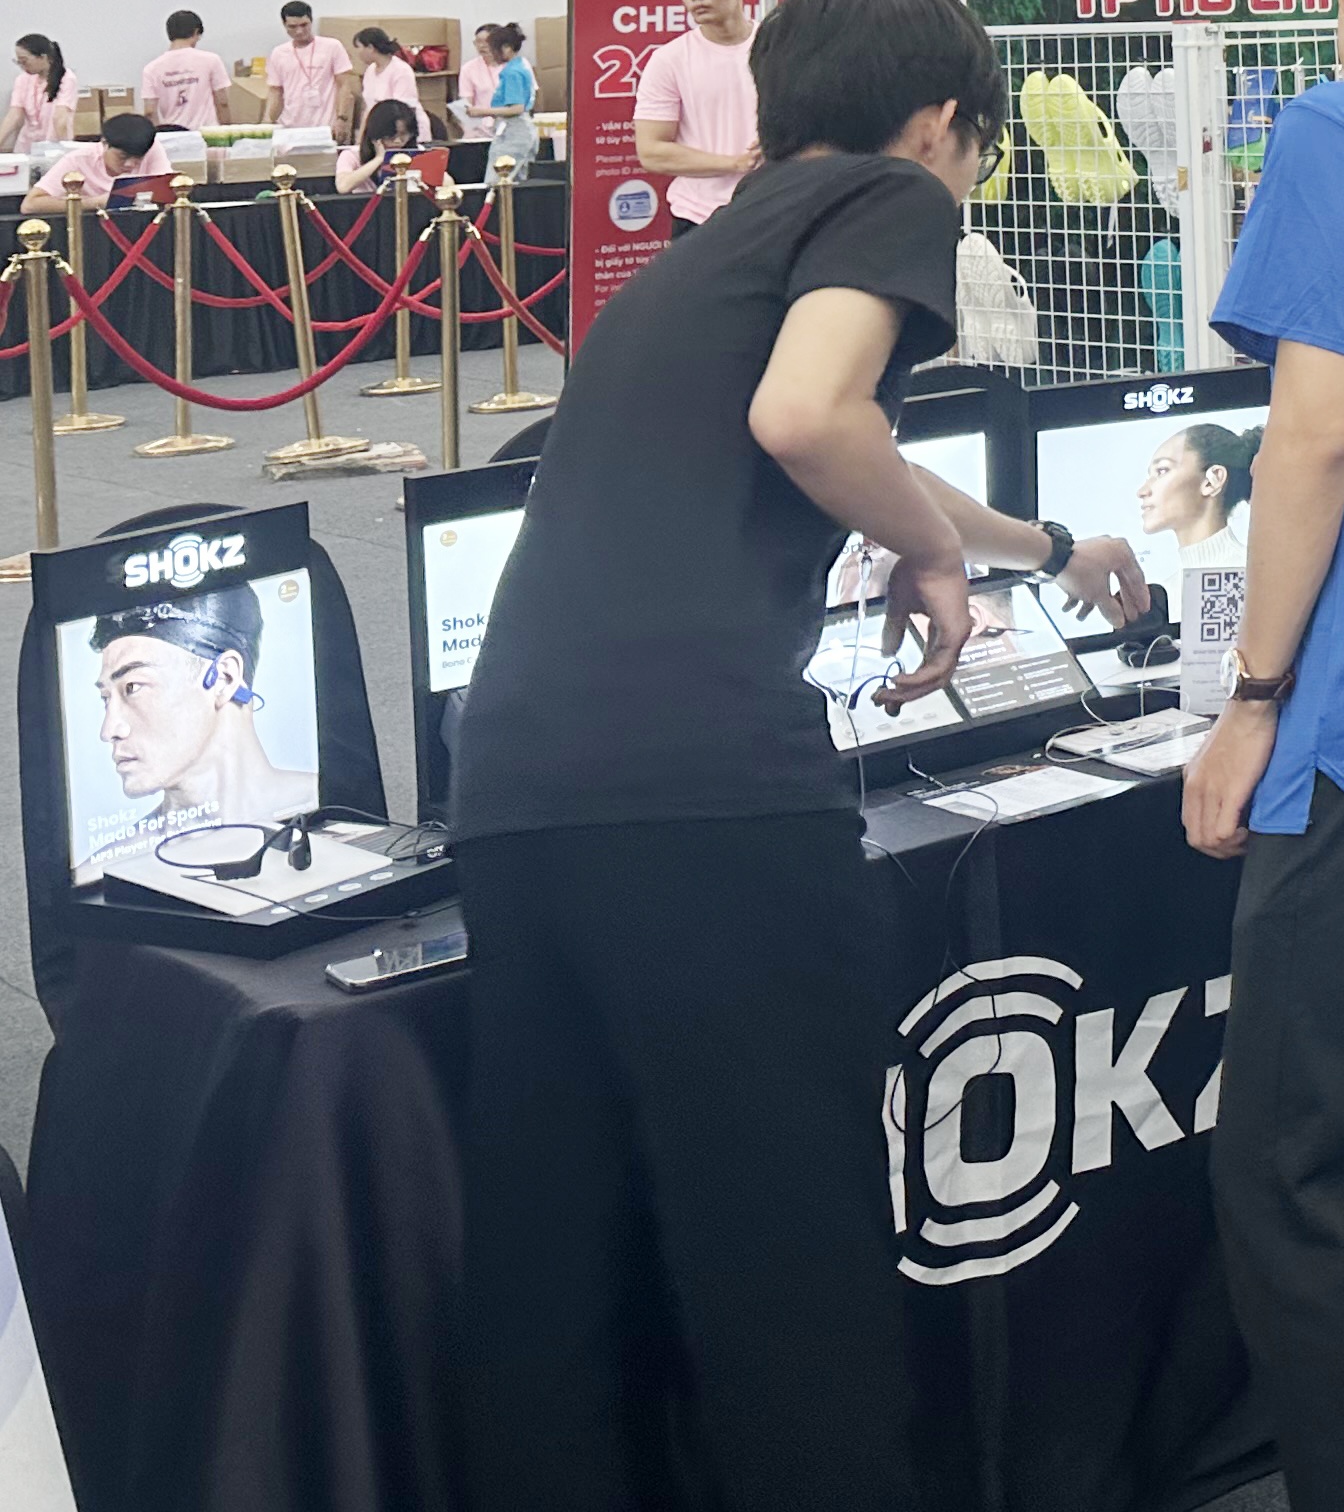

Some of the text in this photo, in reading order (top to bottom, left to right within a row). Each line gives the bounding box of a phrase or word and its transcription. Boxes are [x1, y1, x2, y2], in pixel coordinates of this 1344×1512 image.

[1124, 383, 1194, 413] SHOKZ
[124, 533, 246, 588] SHOKZ
[441, 613, 485, 632] Shok
[442, 634, 482, 653] Mad
[138, 818, 165, 836] For
[166, 799, 220, 826] Sports
[90, 849, 113, 865] MP3
[115, 839, 148, 858] Player
